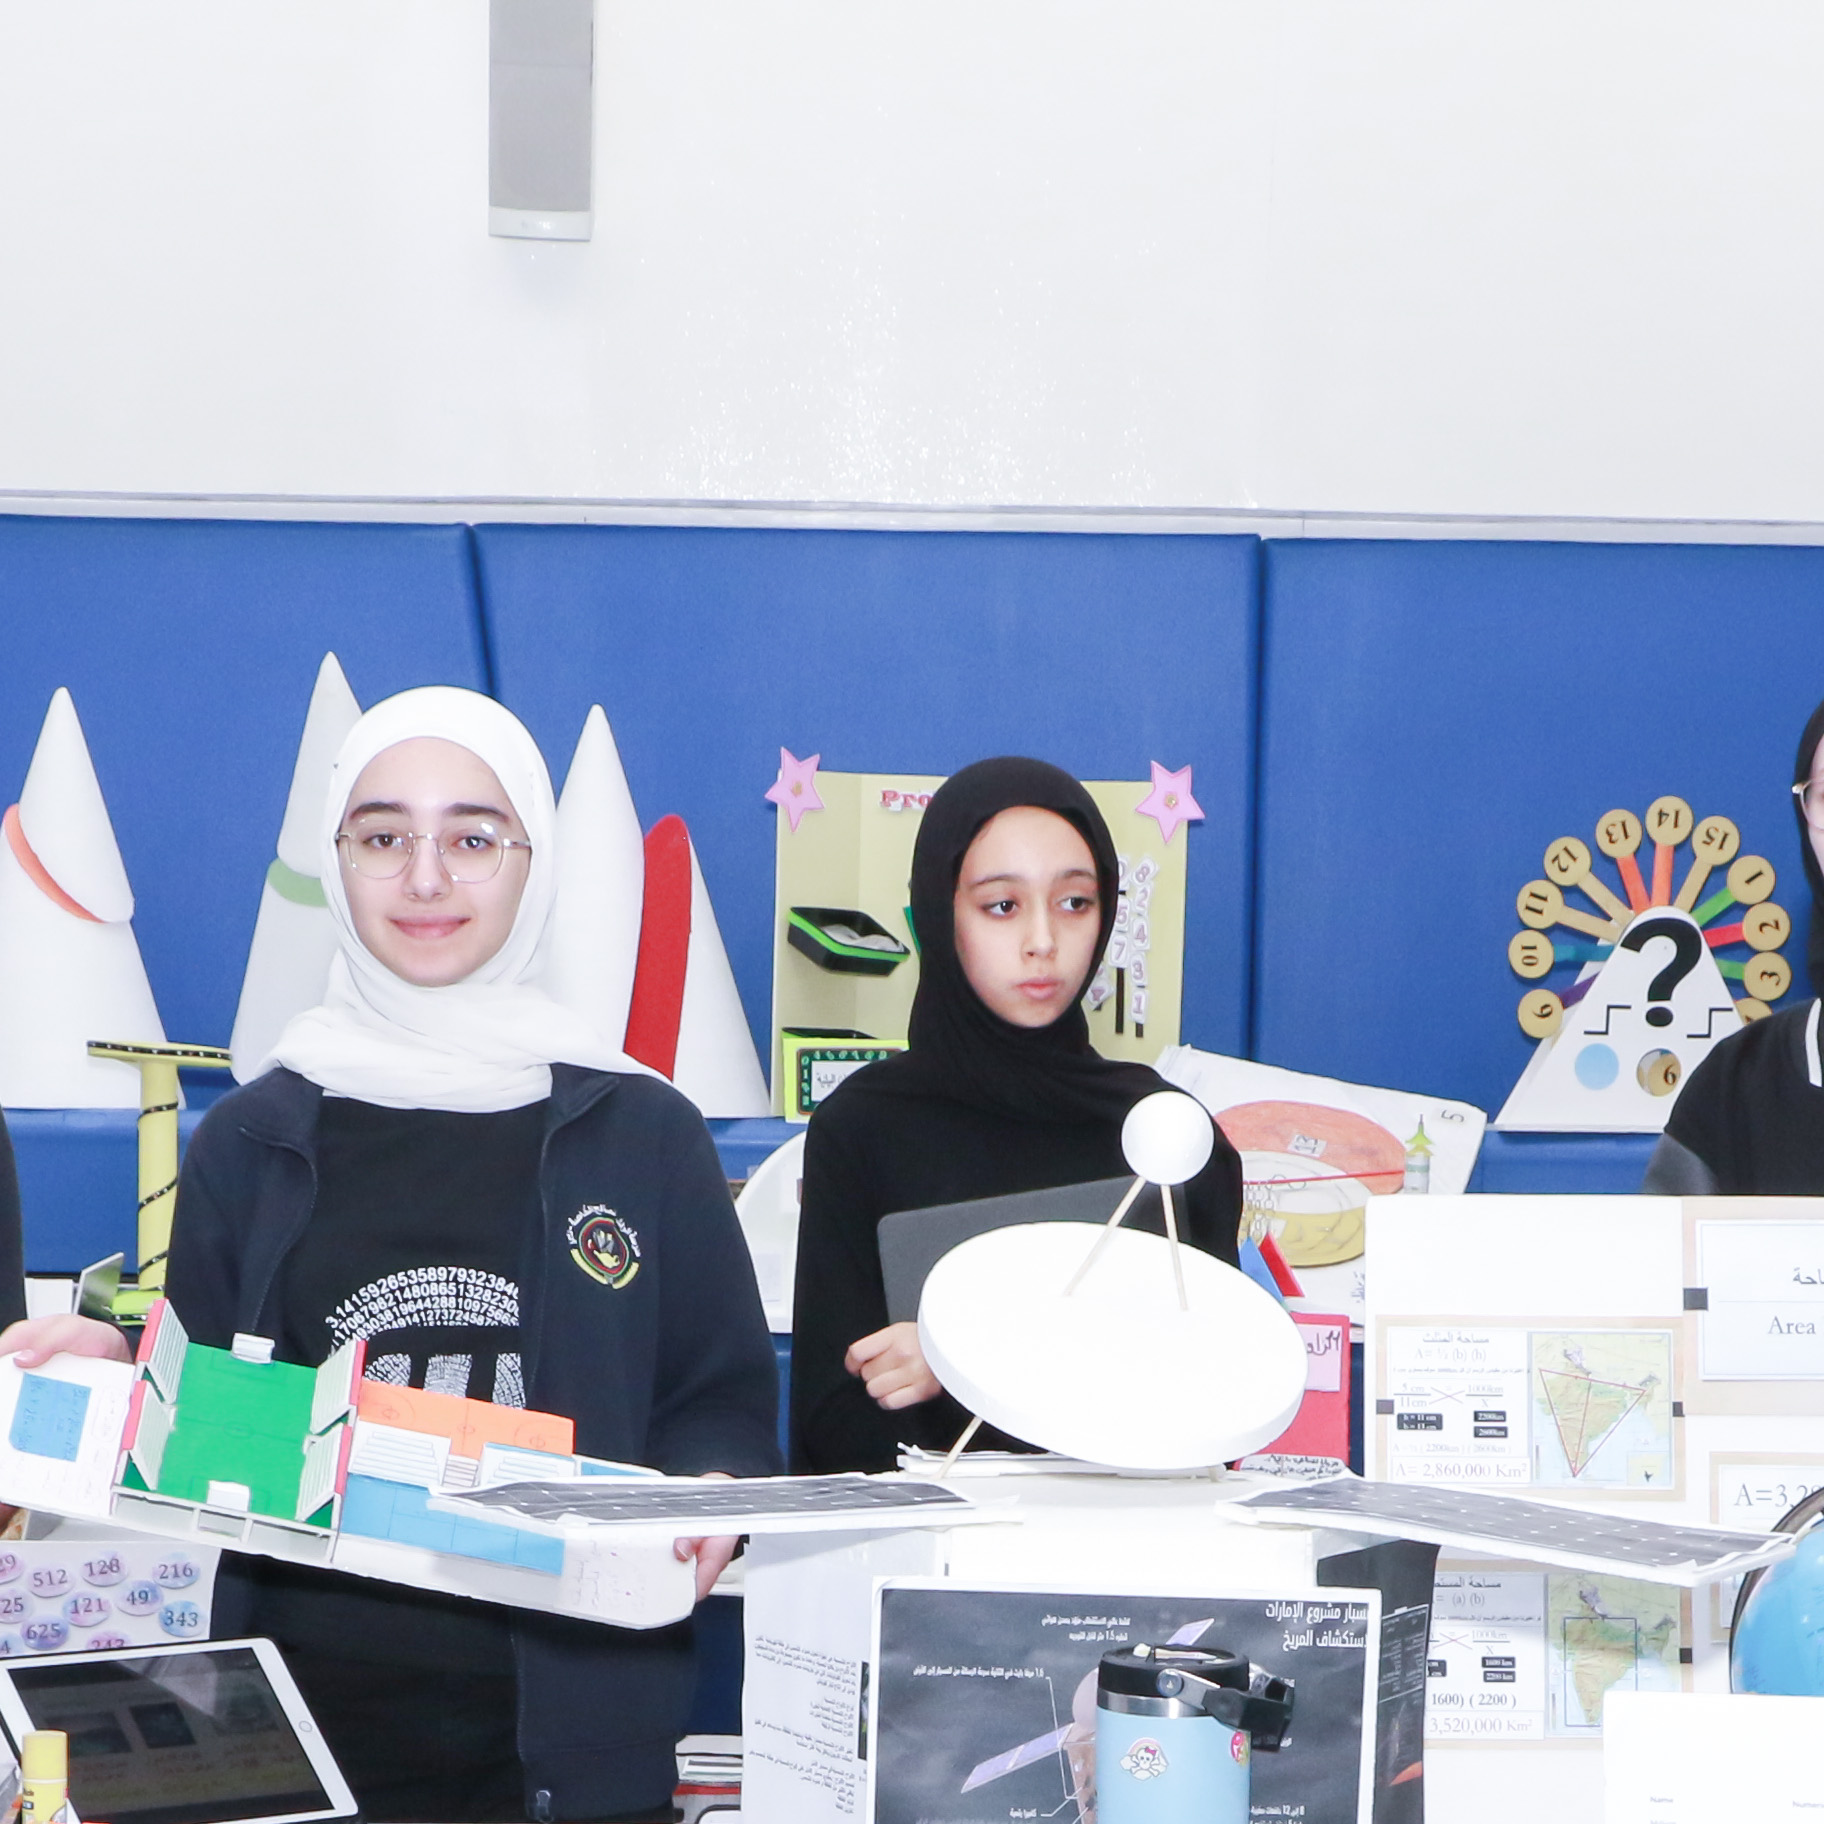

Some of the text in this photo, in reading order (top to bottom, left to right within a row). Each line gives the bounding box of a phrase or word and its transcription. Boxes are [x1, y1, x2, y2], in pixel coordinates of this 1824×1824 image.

[1656, 807, 1680, 829] 14
[1605, 820, 1631, 844] 13
[1702, 825, 1729, 851] 15
[1551, 845, 1579, 873] 12
[1134, 863, 1151, 883] 8
[1137, 889, 1149, 909] 2
[1524, 891, 1549, 917] 11
[1134, 923, 1148, 945] 4
[1759, 918, 1781, 934] 2
[1113, 940, 1127, 961] 7
[1520, 944, 1539, 968] 10
[1132, 959, 1146, 980] 3
[1759, 969, 1782, 986] 3
[1767, 1315, 1816, 1336] Area
[1423, 1462, 1491, 1479] 2,860,000
[32, 1568, 67, 1588] 512
[159, 1562, 193, 1581] 216
[70, 1596, 104, 1615] 121
[125, 1589, 150, 1607] 49
[163, 1608, 198, 1629] 343
[1266, 1601, 1304, 1623] الإمارات
[1307, 1601, 1341, 1624] مشروع
[26, 1623, 61, 1641] 625
[1282, 1629, 1314, 1652] المريخ
[1478, 1693, 1508, 1706] 2200
[1429, 1717, 1502, 1734] 3,520,000
